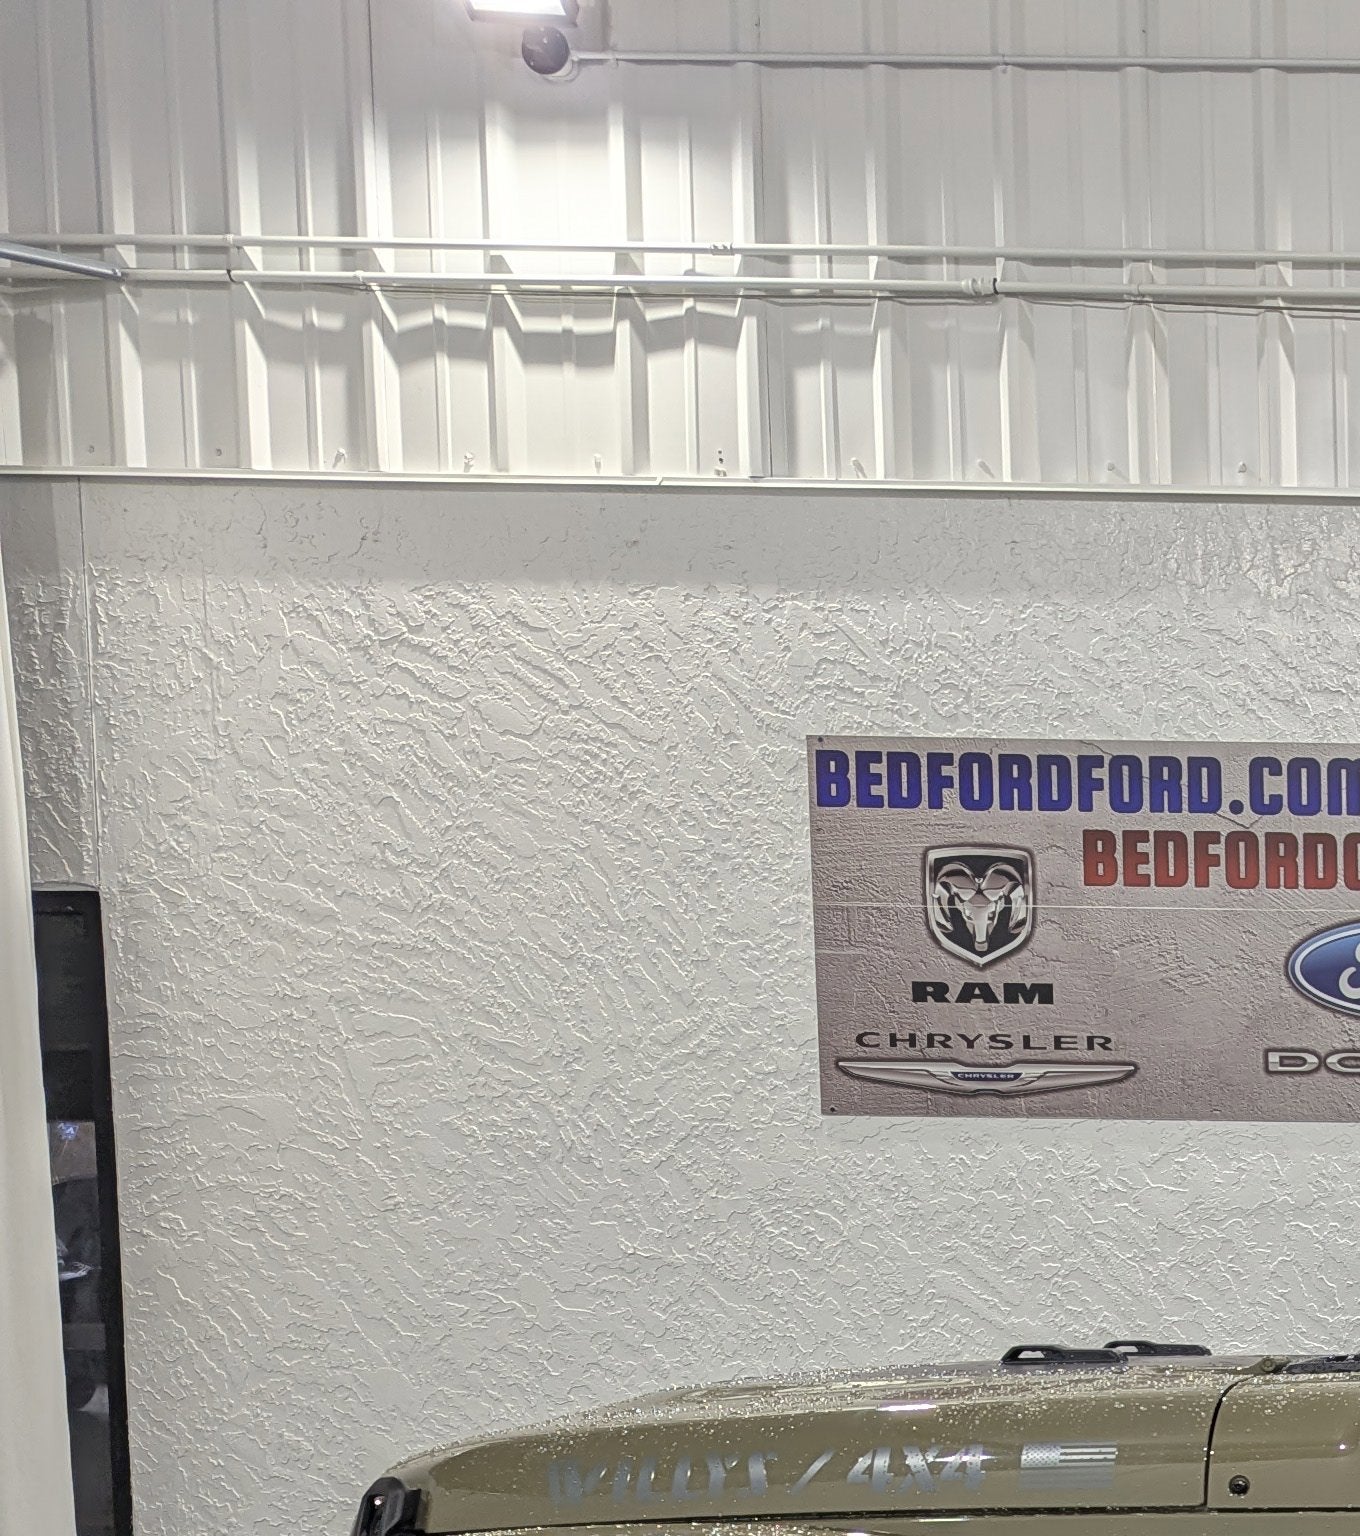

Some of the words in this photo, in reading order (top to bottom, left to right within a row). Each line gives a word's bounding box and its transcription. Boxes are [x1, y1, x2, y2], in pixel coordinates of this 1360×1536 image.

[911, 980, 1054, 1005] RAM
[855, 1031, 1113, 1051] CHRYSLER
[957, 1072, 1015, 1080] CHRYSLER
